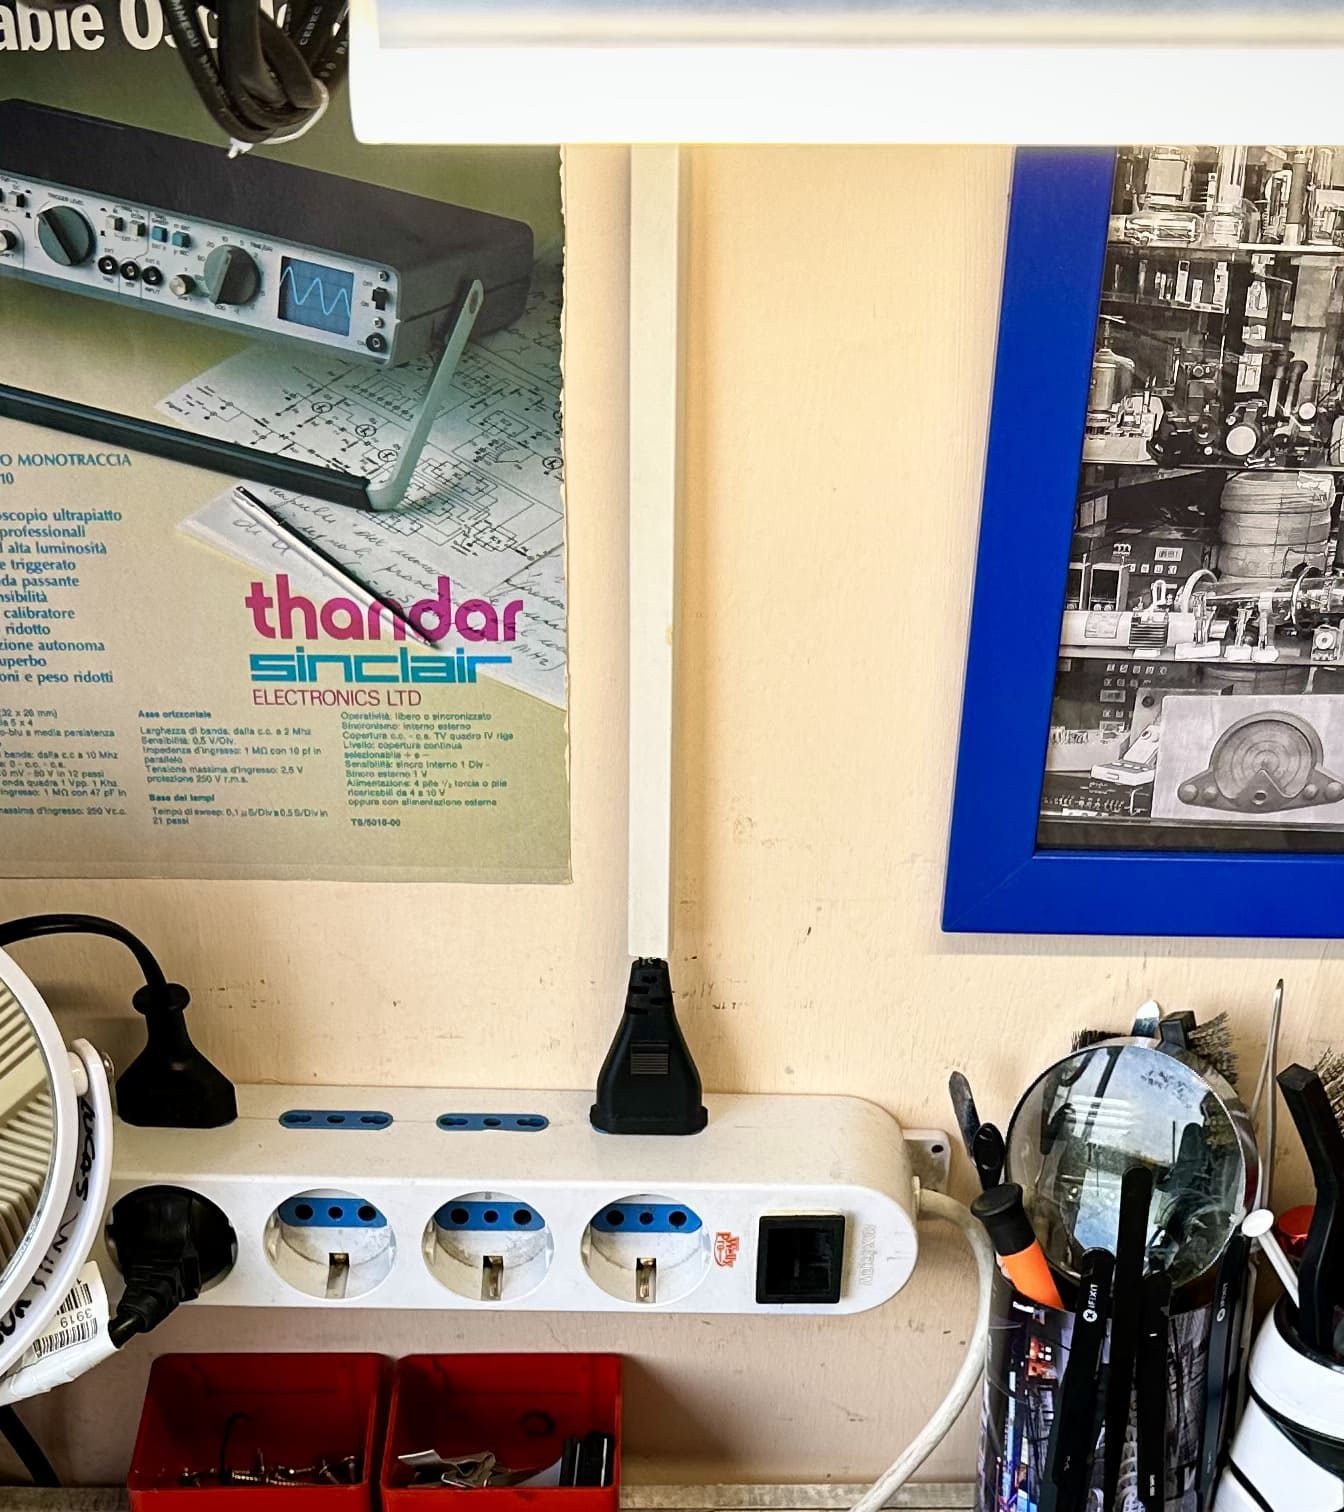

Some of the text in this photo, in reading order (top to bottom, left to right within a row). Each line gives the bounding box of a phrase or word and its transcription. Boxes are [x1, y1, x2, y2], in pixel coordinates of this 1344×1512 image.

[18, 453, 132, 467] MONOTRACCIA
[53, 508, 123, 524] ultrapiatto
[0, 525, 86, 541] professionali
[8, 542, 31, 554] alta
[36, 542, 107, 555] luminosità
[11, 559, 76, 574] triggerato
[22, 577, 80, 592] passante
[4, 606, 75, 619] calibratore
[245, 574, 524, 642] thandar
[6, 623, 50, 635] ridotto
[38, 639, 105, 651] autonoma
[250, 646, 512, 683] sinclair
[25, 673, 32, 682] e
[37, 673, 68, 686] peso
[74, 670, 113, 683] ridotti
[253, 689, 421, 706] ELECTRONICS LTD
[59, 1309, 93, 1329] 3919
